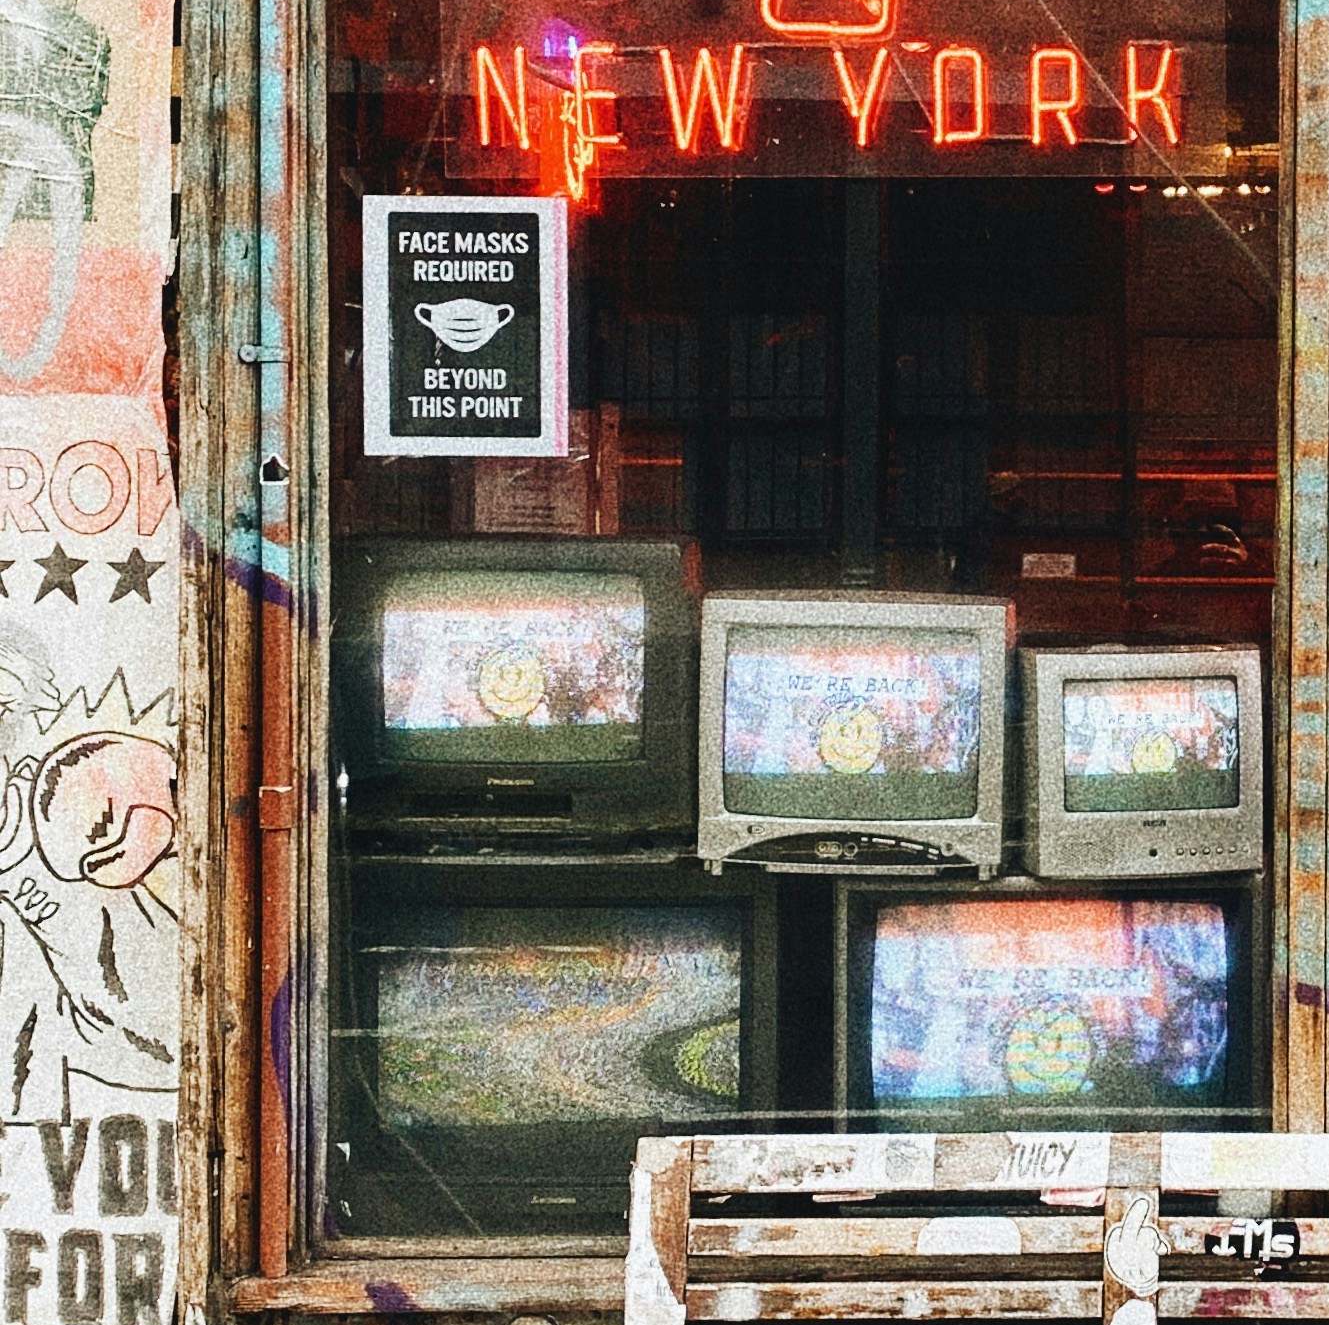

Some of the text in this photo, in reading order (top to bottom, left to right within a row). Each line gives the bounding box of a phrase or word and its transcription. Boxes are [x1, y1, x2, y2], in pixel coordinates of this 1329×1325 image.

[474, 44, 1182, 151] NEW YORK
[398, 231, 529, 254] FACE MASKS
[413, 260, 514, 282] REQUIRED
[423, 368, 507, 390] BEYOND
[408, 396, 522, 418] THIS POINT
[788, 674, 854, 692] WE'RE
